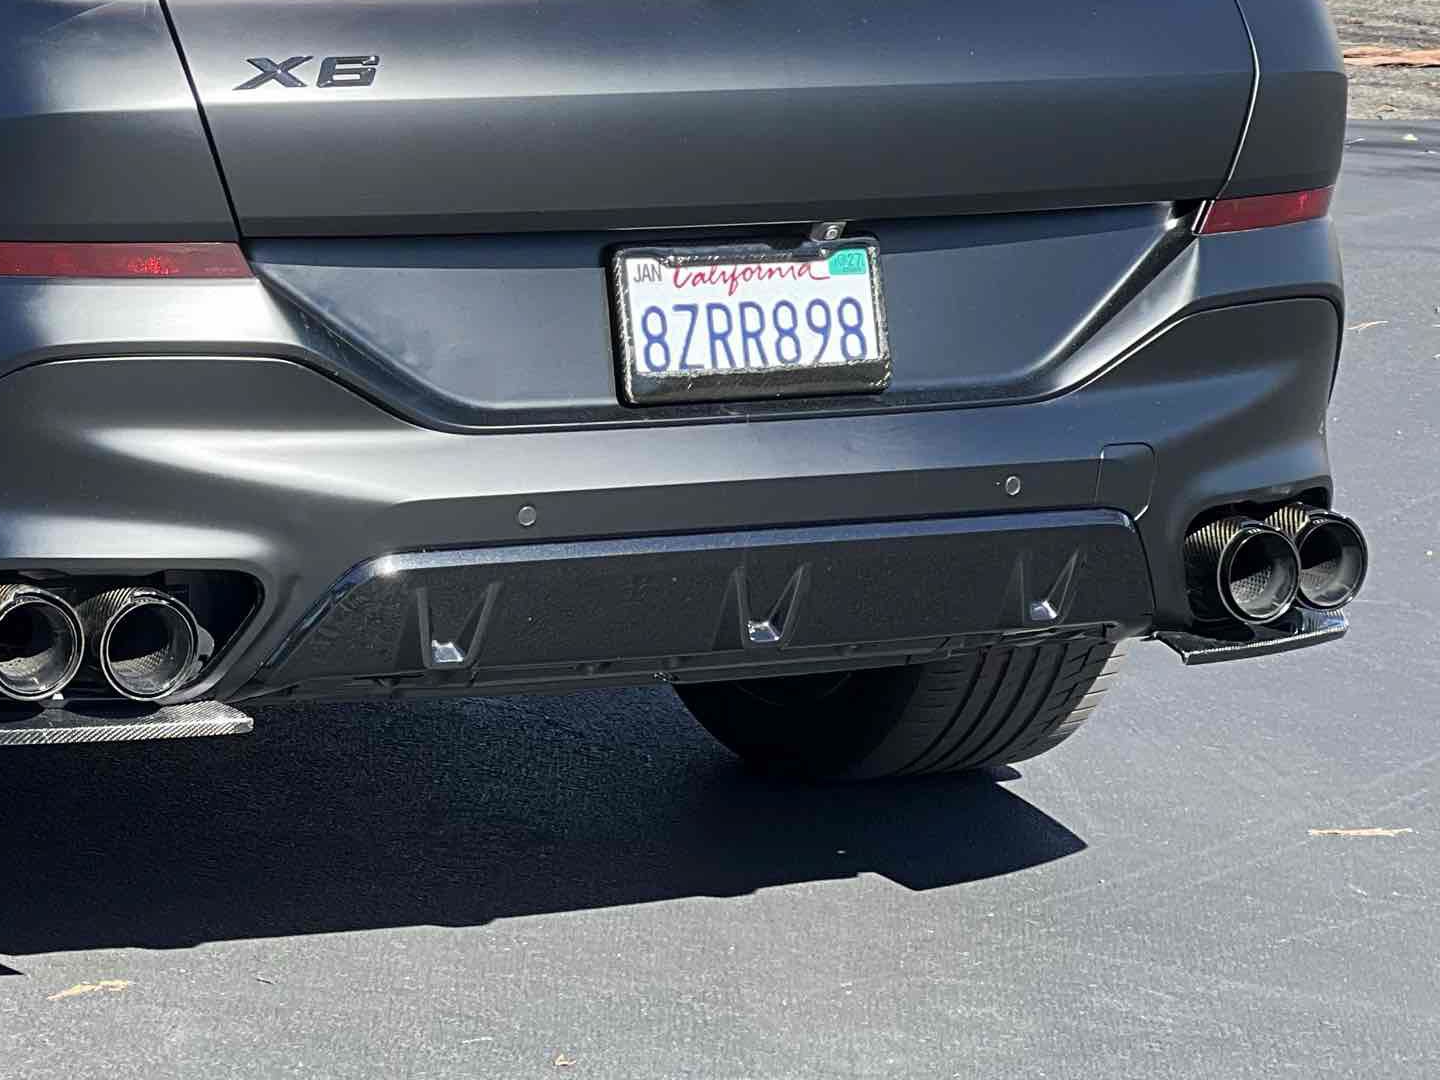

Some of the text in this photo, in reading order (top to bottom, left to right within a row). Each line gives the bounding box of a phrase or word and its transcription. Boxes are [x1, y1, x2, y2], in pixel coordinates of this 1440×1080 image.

[231, 55, 380, 91] X6
[633, 264, 663, 283] JAN
[672, 262, 831, 296] California
[641, 296, 868, 373] 8ZRR898
